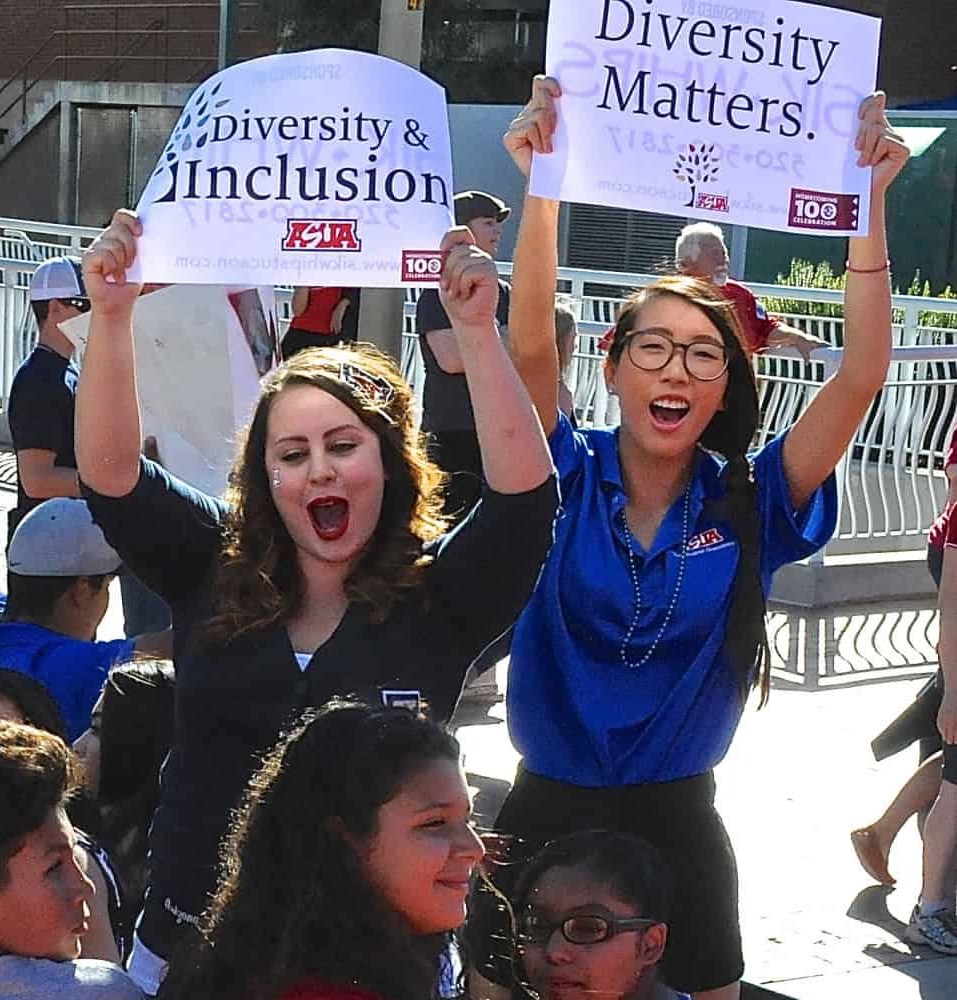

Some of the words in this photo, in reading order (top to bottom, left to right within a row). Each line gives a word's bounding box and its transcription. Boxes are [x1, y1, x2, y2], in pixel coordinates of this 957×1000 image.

[595, 0, 840, 85] Diversity
[597, 65, 815, 140] Matters.
[210, 107, 392, 151] Diversity
[403, 118, 430, 150] &
[182, 153, 449, 207] Inclusion
[794, 200, 838, 220] 100
[284, 221, 359, 250] ASUA
[405, 258, 442, 273] 100
